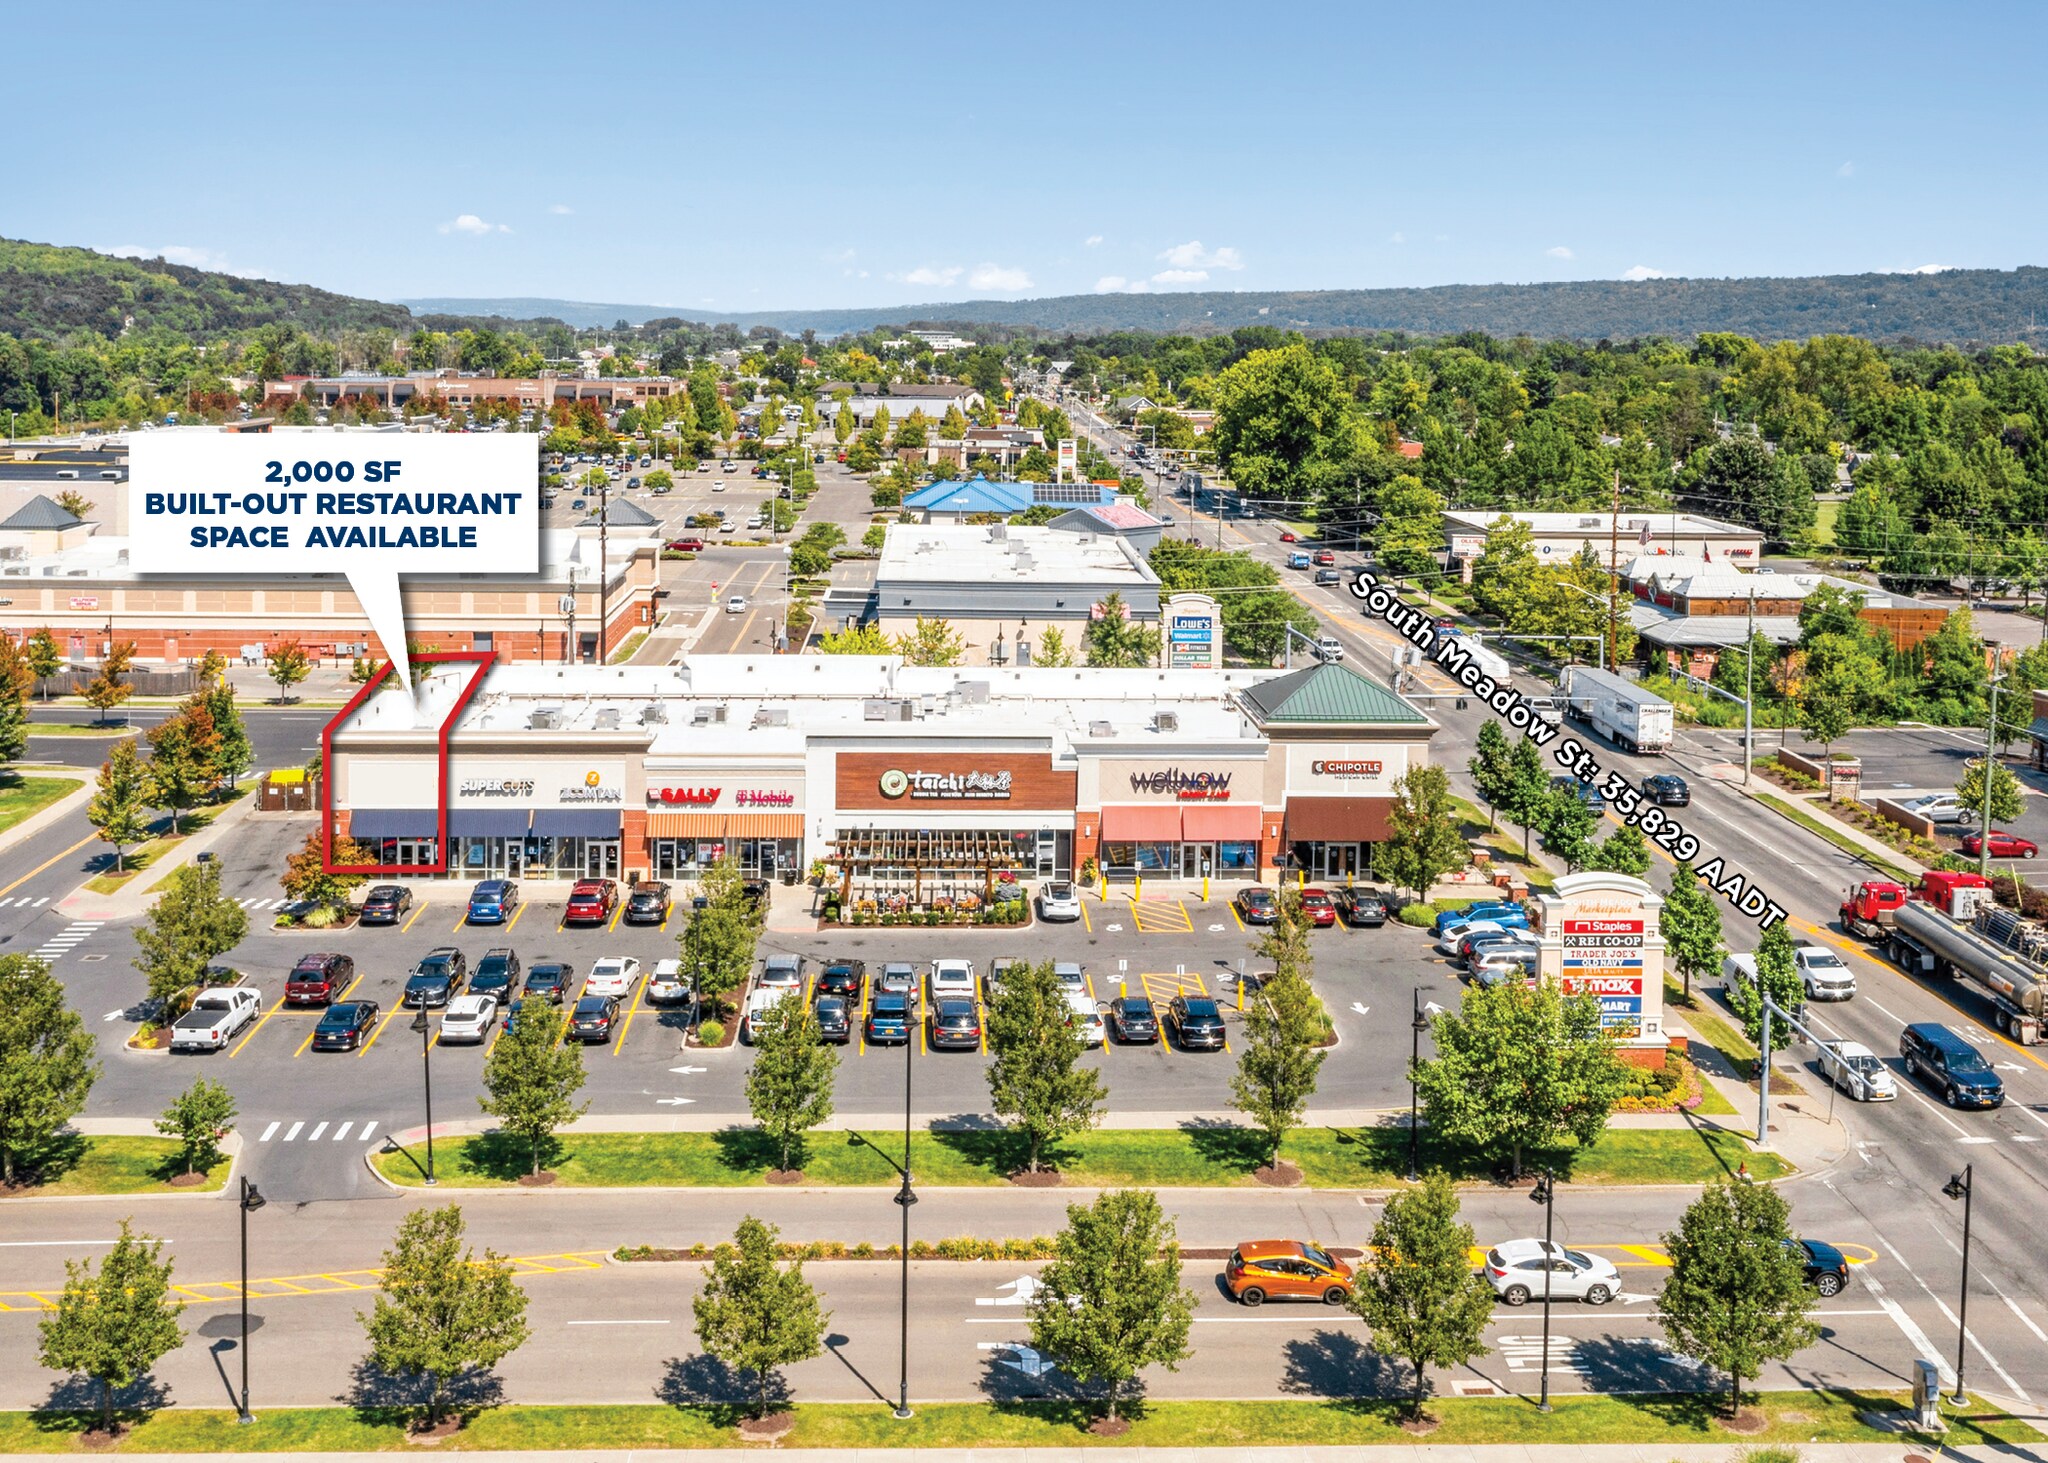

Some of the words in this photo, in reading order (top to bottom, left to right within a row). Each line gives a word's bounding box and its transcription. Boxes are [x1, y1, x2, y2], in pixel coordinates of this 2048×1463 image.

[1174, 616, 1211, 629] LOWE'S
[1173, 632, 1202, 640] Walmart
[1327, 763, 1380, 771] CHIPOTLE
[461, 778, 535, 794] SUPERCUTS
[660, 788, 722, 804] SALLY
[1573, 903, 1632, 917] Marketplace
[1593, 921, 1632, 932] Staples
[1578, 937, 1600, 946] REI
[1604, 937, 1641, 946] CO-OP
[1571, 950, 1607, 958] TRADER
[1610, 950, 1636, 958] JOE'S
[1583, 968, 1601, 976] ULTA
[1497, 1335, 1593, 1374] ONLY
